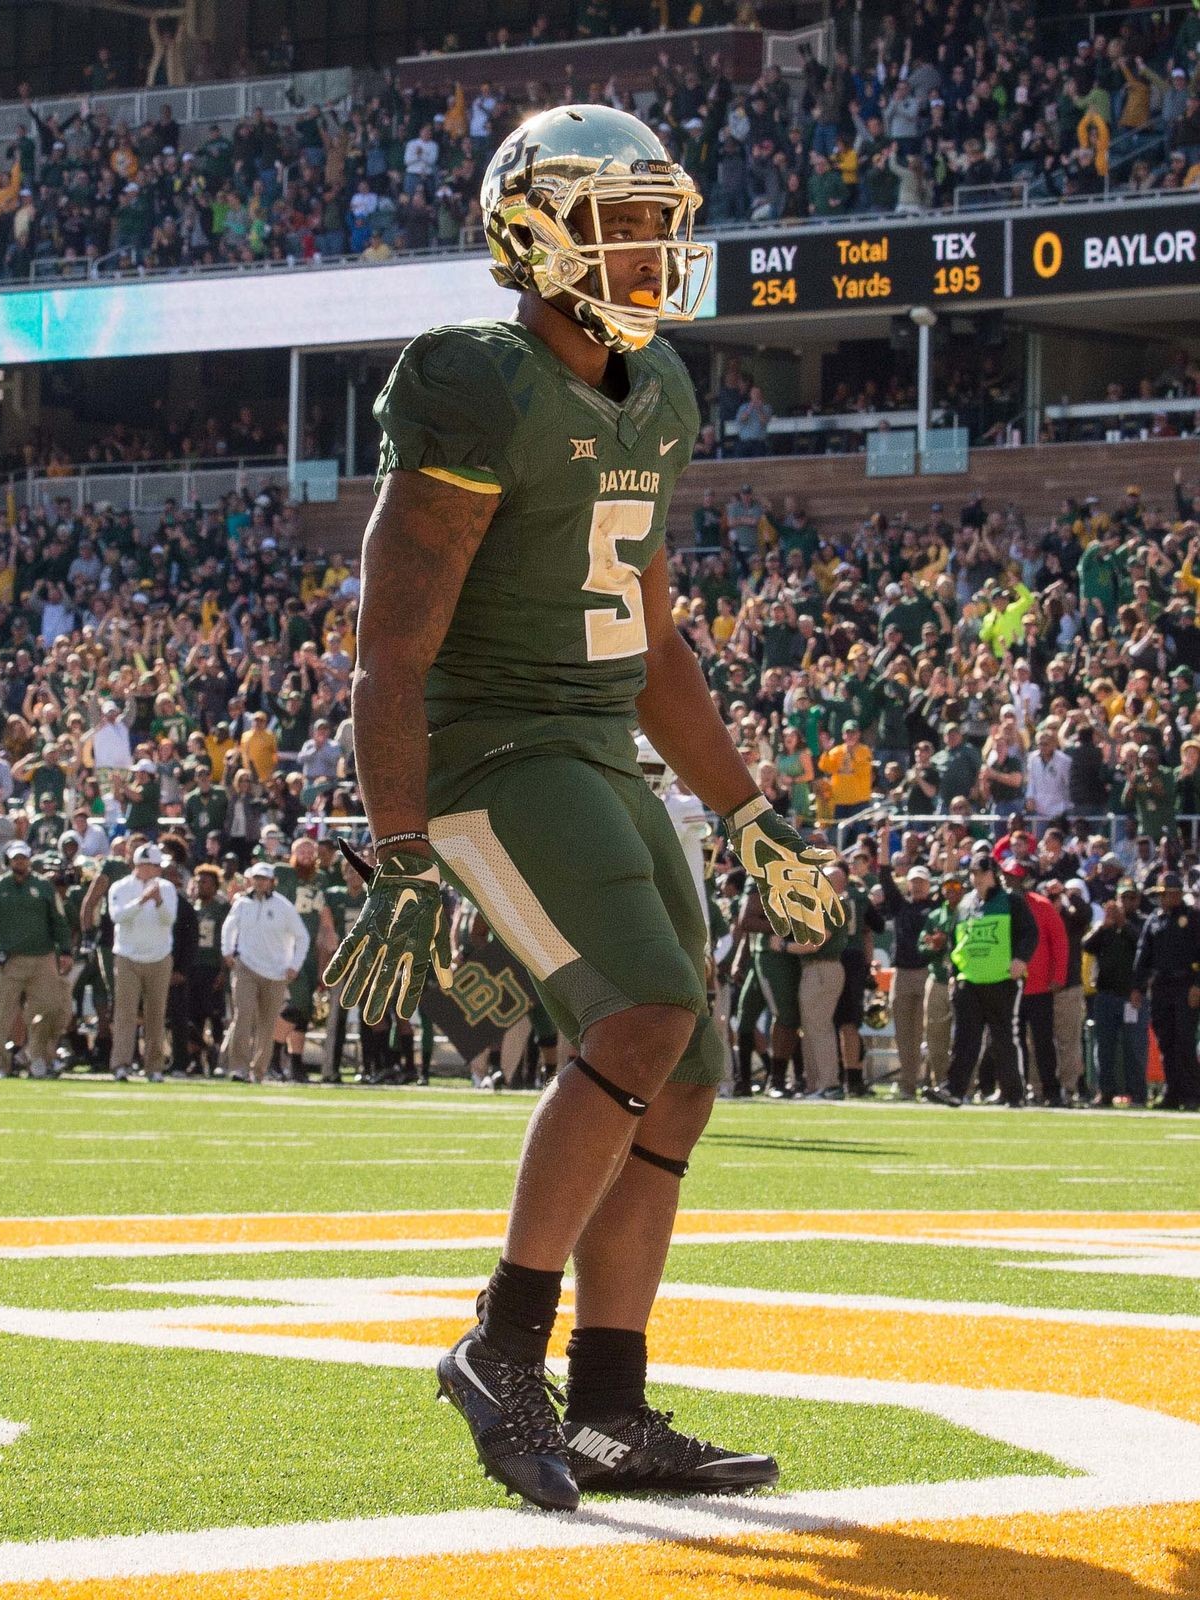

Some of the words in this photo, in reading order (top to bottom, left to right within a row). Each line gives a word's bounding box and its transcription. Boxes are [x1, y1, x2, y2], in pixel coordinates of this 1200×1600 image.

[751, 245, 798, 274] BAY
[836, 232, 889, 265] Total
[932, 231, 977, 261] TEX
[1033, 231, 1062, 279] 0
[1084, 229, 1197, 270] BAYLOR
[751, 278, 797, 307] 254
[832, 271, 892, 300] Yards
[933, 264, 982, 295] 195
[600, 469, 660, 494] BAYLOR
[581, 500, 655, 662] 5
[566, 1425, 632, 1469] NIKE
